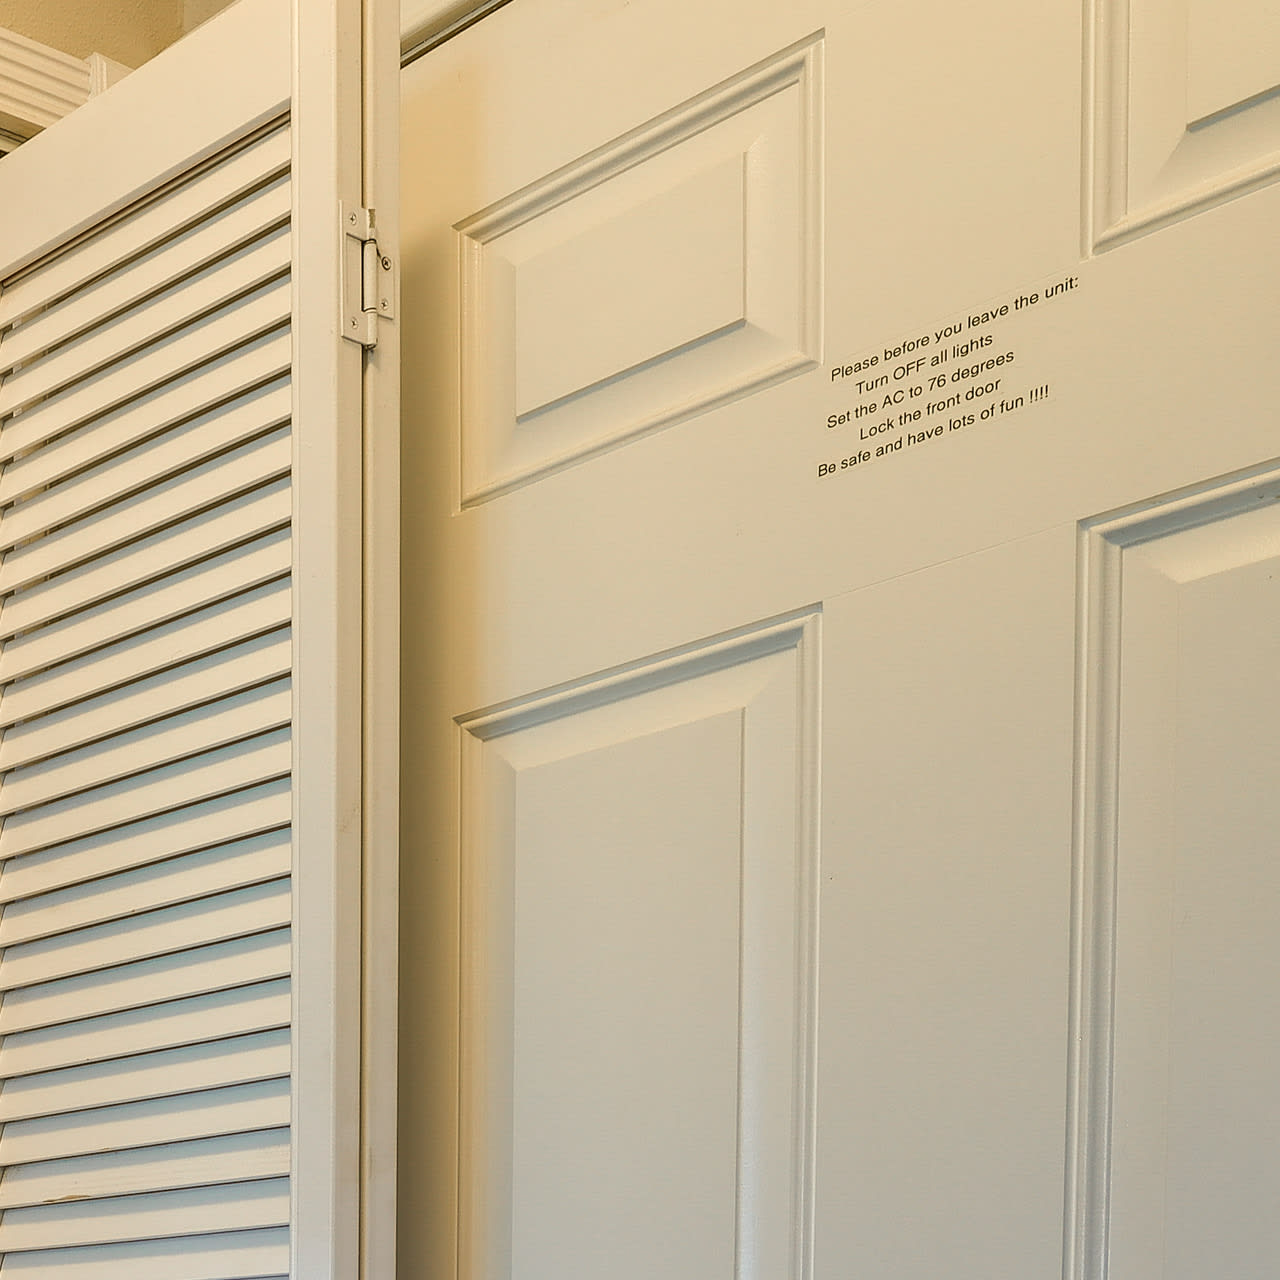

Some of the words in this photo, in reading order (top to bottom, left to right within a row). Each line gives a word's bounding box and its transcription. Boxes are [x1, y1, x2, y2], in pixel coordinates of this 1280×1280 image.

[831, 356, 879, 382] Please
[883, 335, 930, 361] before
[934, 322, 962, 344] you
[967, 304, 1009, 329] leave
[1014, 293, 1039, 311] the
[1044, 276, 1079, 299] unit:
[856, 374, 889, 395] Turn
[893, 357, 926, 380] OFF
[931, 350, 947, 366] all
[952, 335, 993, 360] lights
[827, 411, 851, 429] Set
[854, 402, 877, 418] the
[882, 391, 905, 409] AC
[909, 384, 923, 398] to
[928, 374, 947, 392] 76
[951, 351, 1015, 385] degrees
[860, 419, 895, 440] Lock
[899, 410, 921, 426] the
[927, 396, 961, 416] front
[965, 378, 1002, 402] door
[817, 463, 836, 477] Be
[840, 452, 871, 470] safe
[876, 437, 903, 457] and
[907, 425, 944, 446] have
[949, 414, 975, 432] lots
[980, 406, 996, 421] of
[999, 397, 1024, 416] fun
[1029, 385, 1049, 403] !!!!
